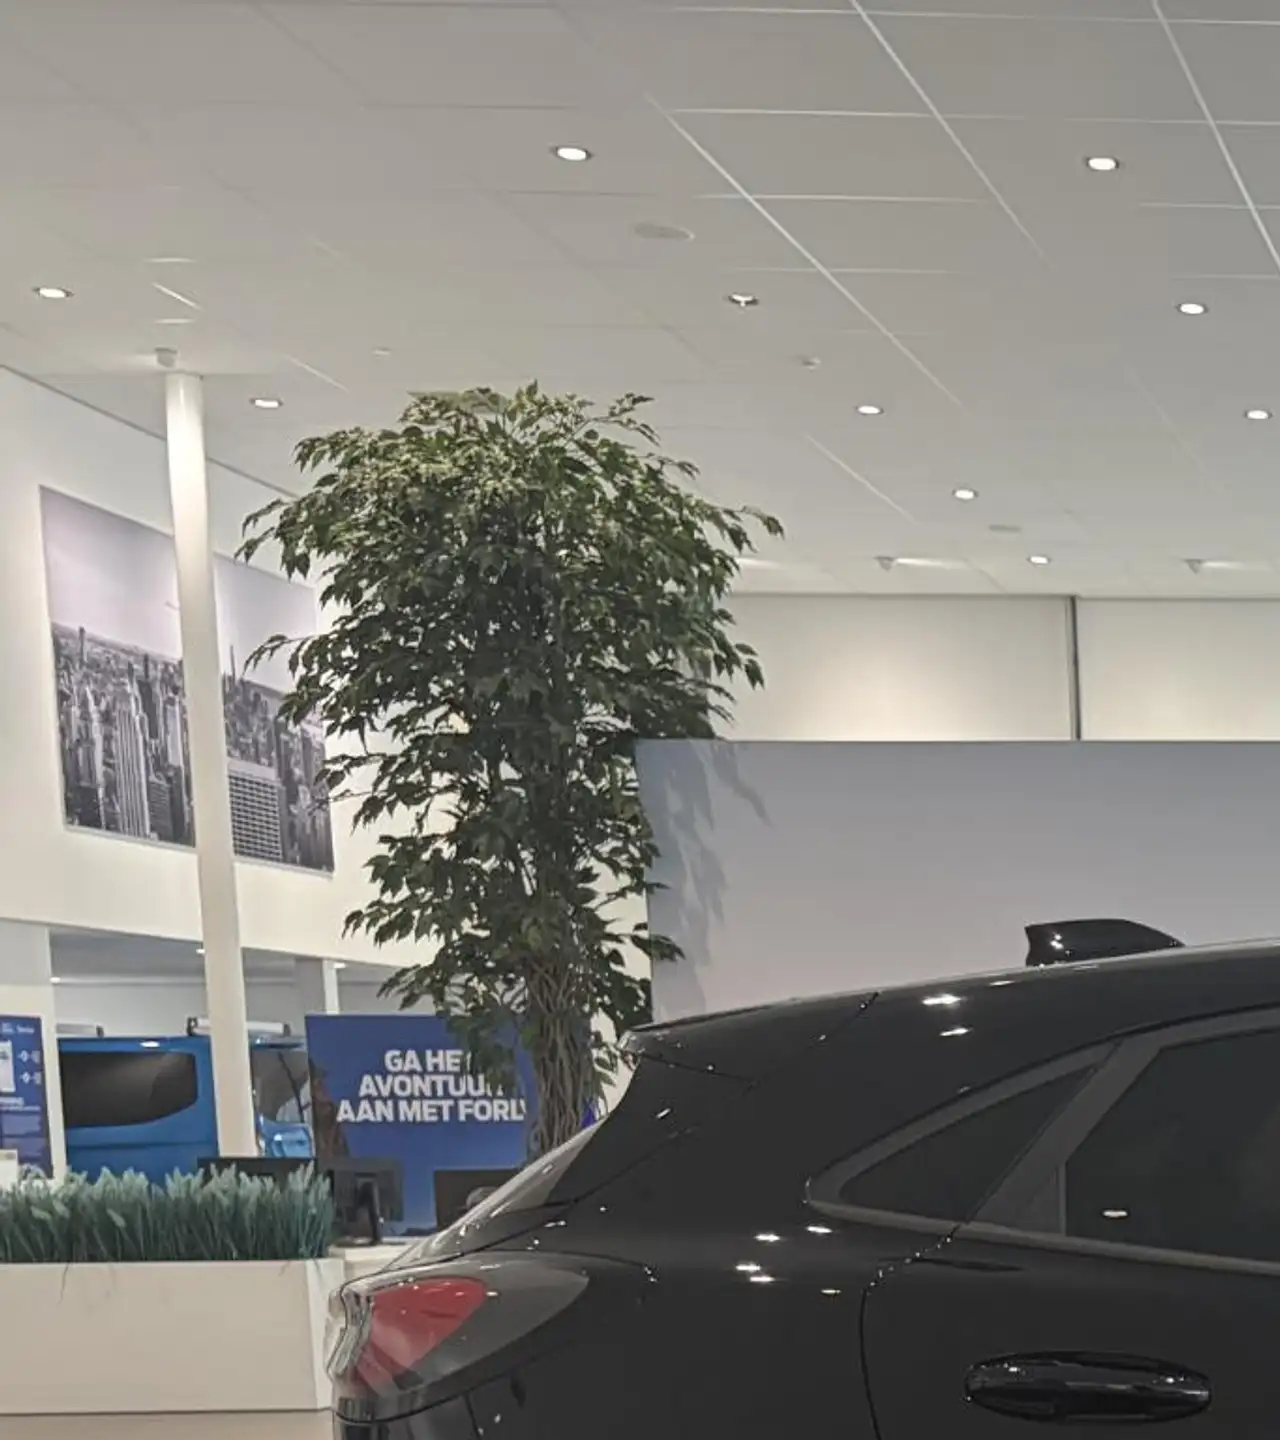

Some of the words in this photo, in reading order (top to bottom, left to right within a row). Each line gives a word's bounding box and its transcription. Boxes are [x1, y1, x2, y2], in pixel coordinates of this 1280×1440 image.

[384, 1049, 423, 1072] GA
[336, 1099, 394, 1122] AAN
[399, 1099, 454, 1122] MET
